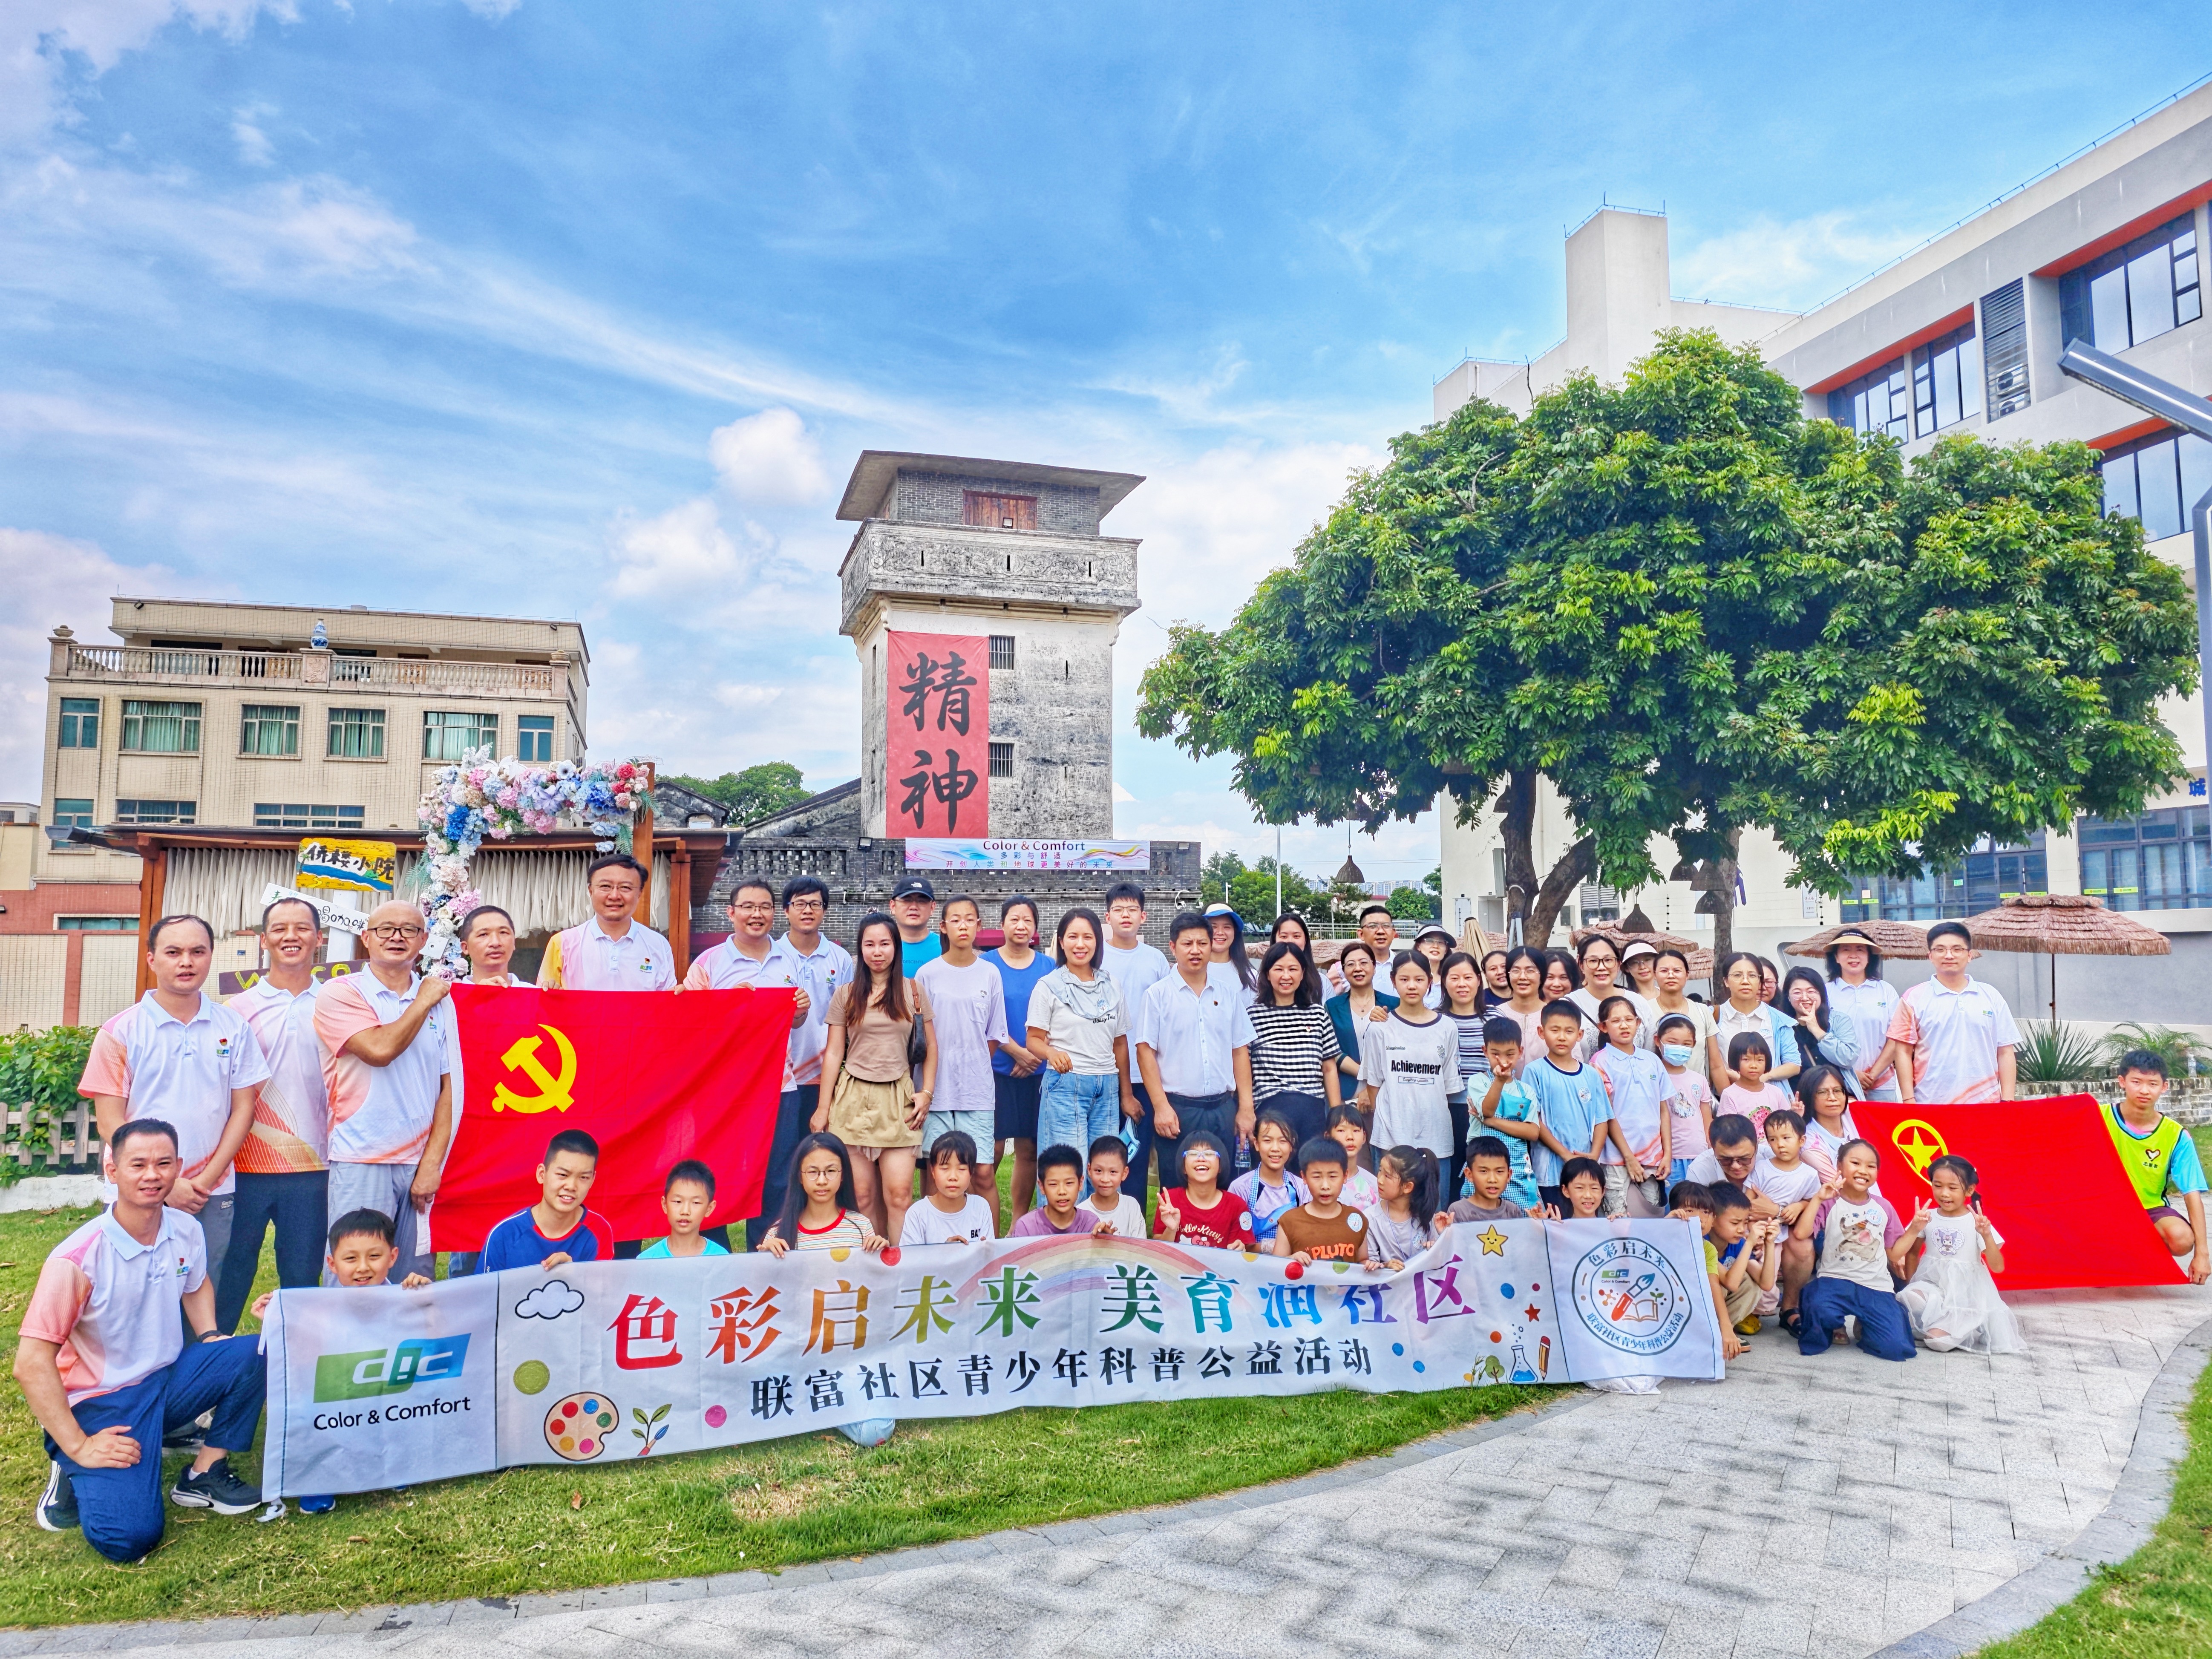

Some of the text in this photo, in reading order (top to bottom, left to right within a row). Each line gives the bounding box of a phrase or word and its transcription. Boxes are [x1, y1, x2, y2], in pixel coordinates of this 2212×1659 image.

[899, 651, 979, 835] 精神
[983, 840, 1085, 850] Color & Comfort
[1391, 1060, 1441, 1075] Achievement
[971, 1229, 981, 1238] BA
[1197, 1224, 1221, 1239] Kitty
[1588, 1241, 1665, 1269] 色彩启未来
[606, 1254, 1476, 1370] 色彩启未来 美育润社区
[1587, 1312, 1684, 1350] 联富社区青少年科普公益活动
[751, 1336, 1372, 1420] 联富社区青少年科普公益活动
[314, 1397, 471, 1430] Color & Comfort
